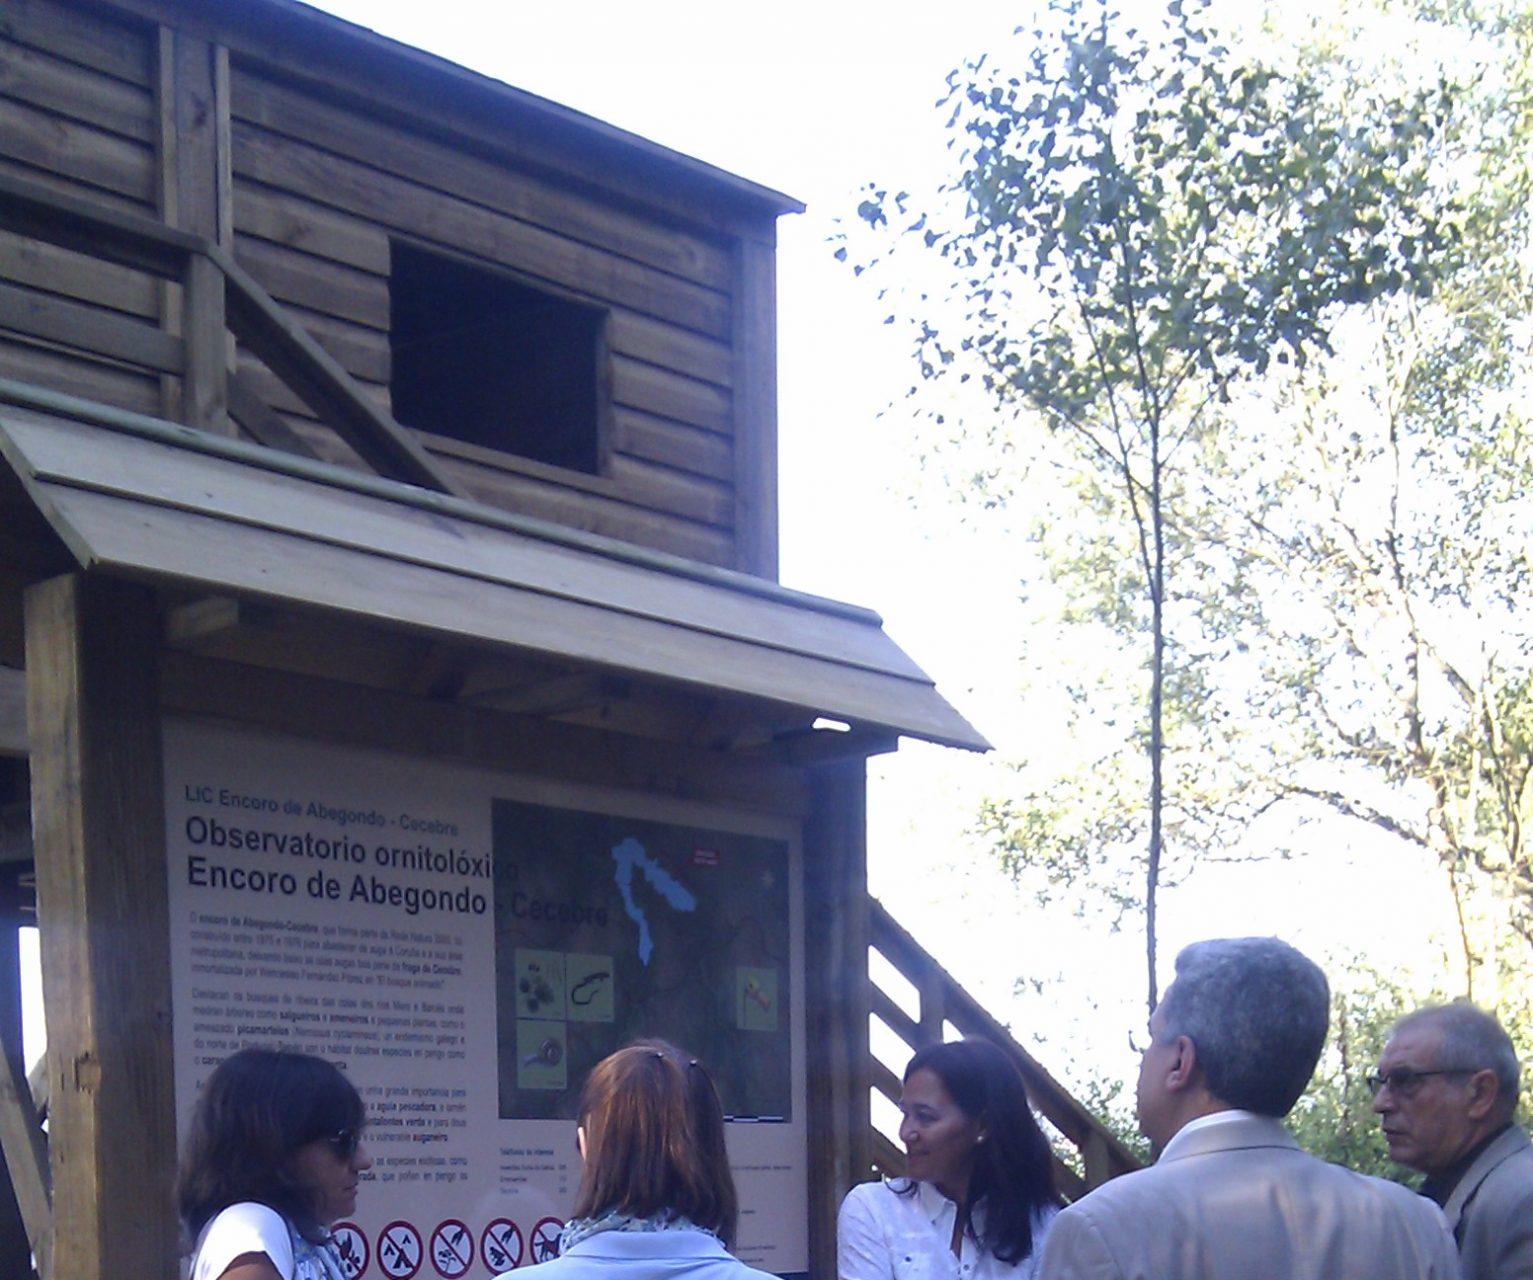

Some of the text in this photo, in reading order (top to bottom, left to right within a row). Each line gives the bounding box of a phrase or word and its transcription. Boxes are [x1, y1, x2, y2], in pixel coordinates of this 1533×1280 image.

[185, 785, 213, 804] LIC
[219, 789, 279, 812] Encoro
[283, 800, 302, 816] de
[306, 802, 385, 827] Abegondo
[399, 814, 459, 837] Cecebre
[186, 816, 366, 863] Observatorio
[188, 855, 297, 895] Encoro
[307, 869, 341, 900] de
[349, 874, 486, 915] Abegondo
[512, 891, 609, 927] Cecebre
[279, 1010, 320, 1023] salgueiros
